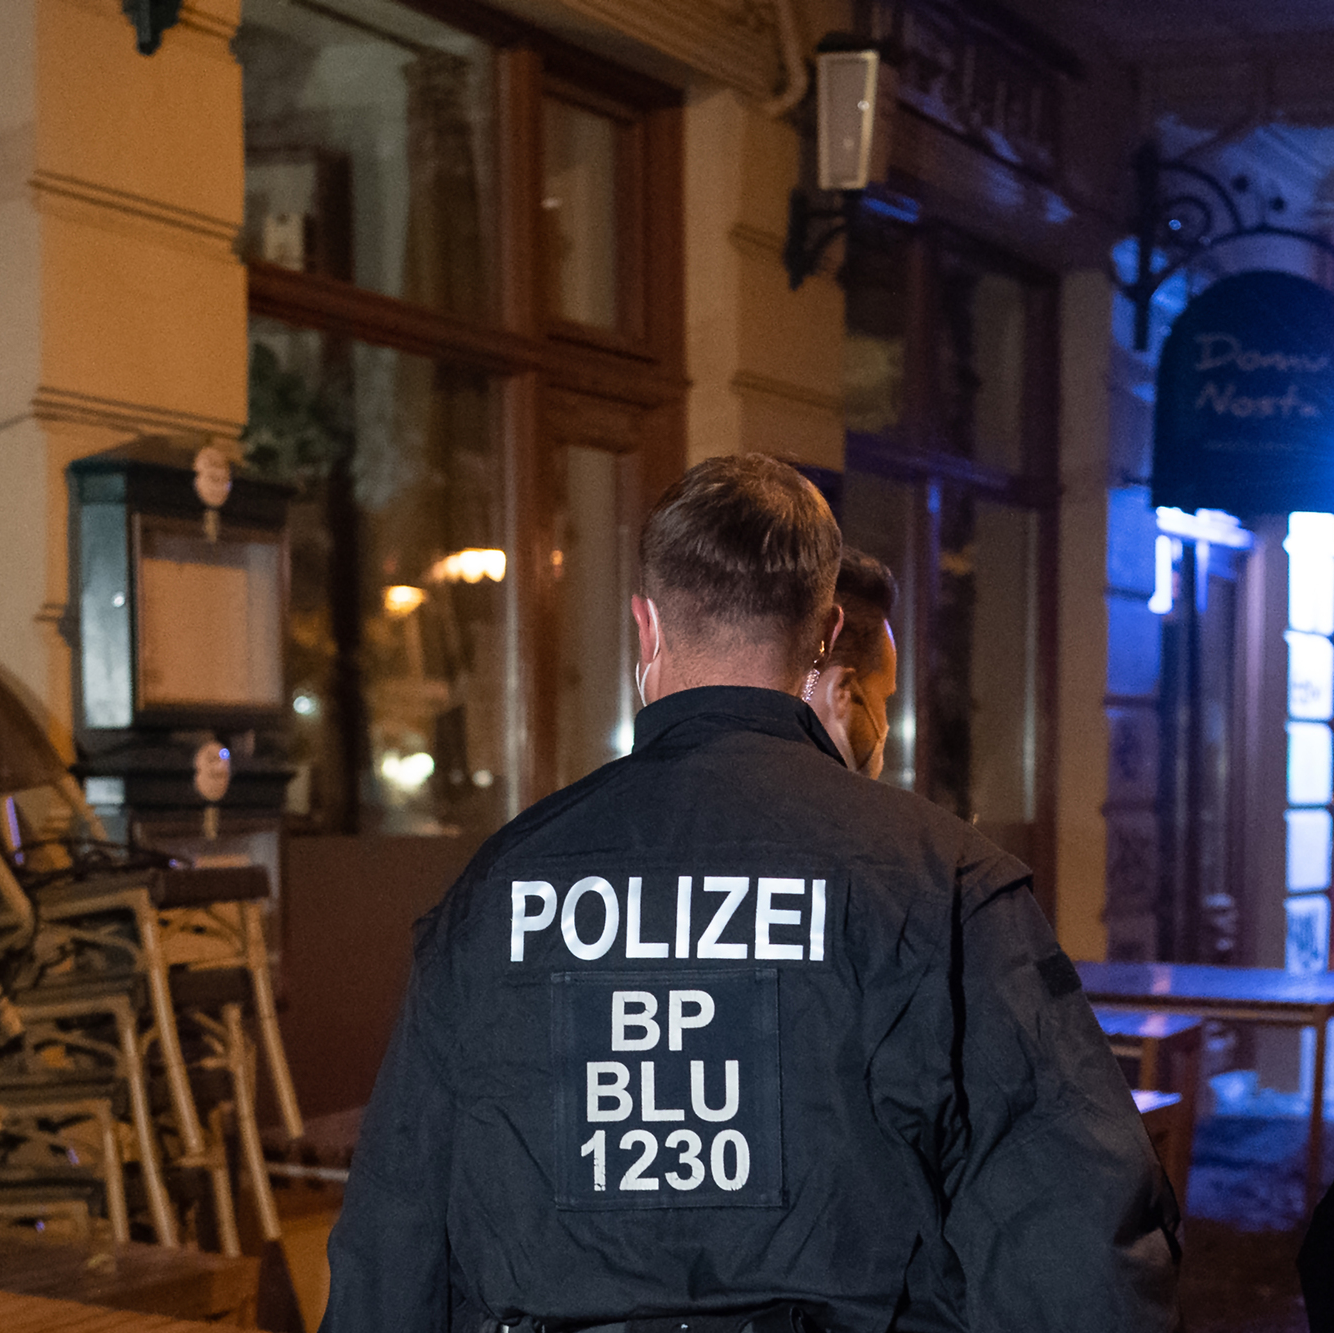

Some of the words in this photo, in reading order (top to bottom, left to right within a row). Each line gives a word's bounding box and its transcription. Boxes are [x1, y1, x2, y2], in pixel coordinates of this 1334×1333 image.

[511, 876, 826, 962] POLIZEI
[612, 990, 715, 1051] BP
[587, 1060, 739, 1122] BLU
[581, 1129, 750, 1191] 1230
